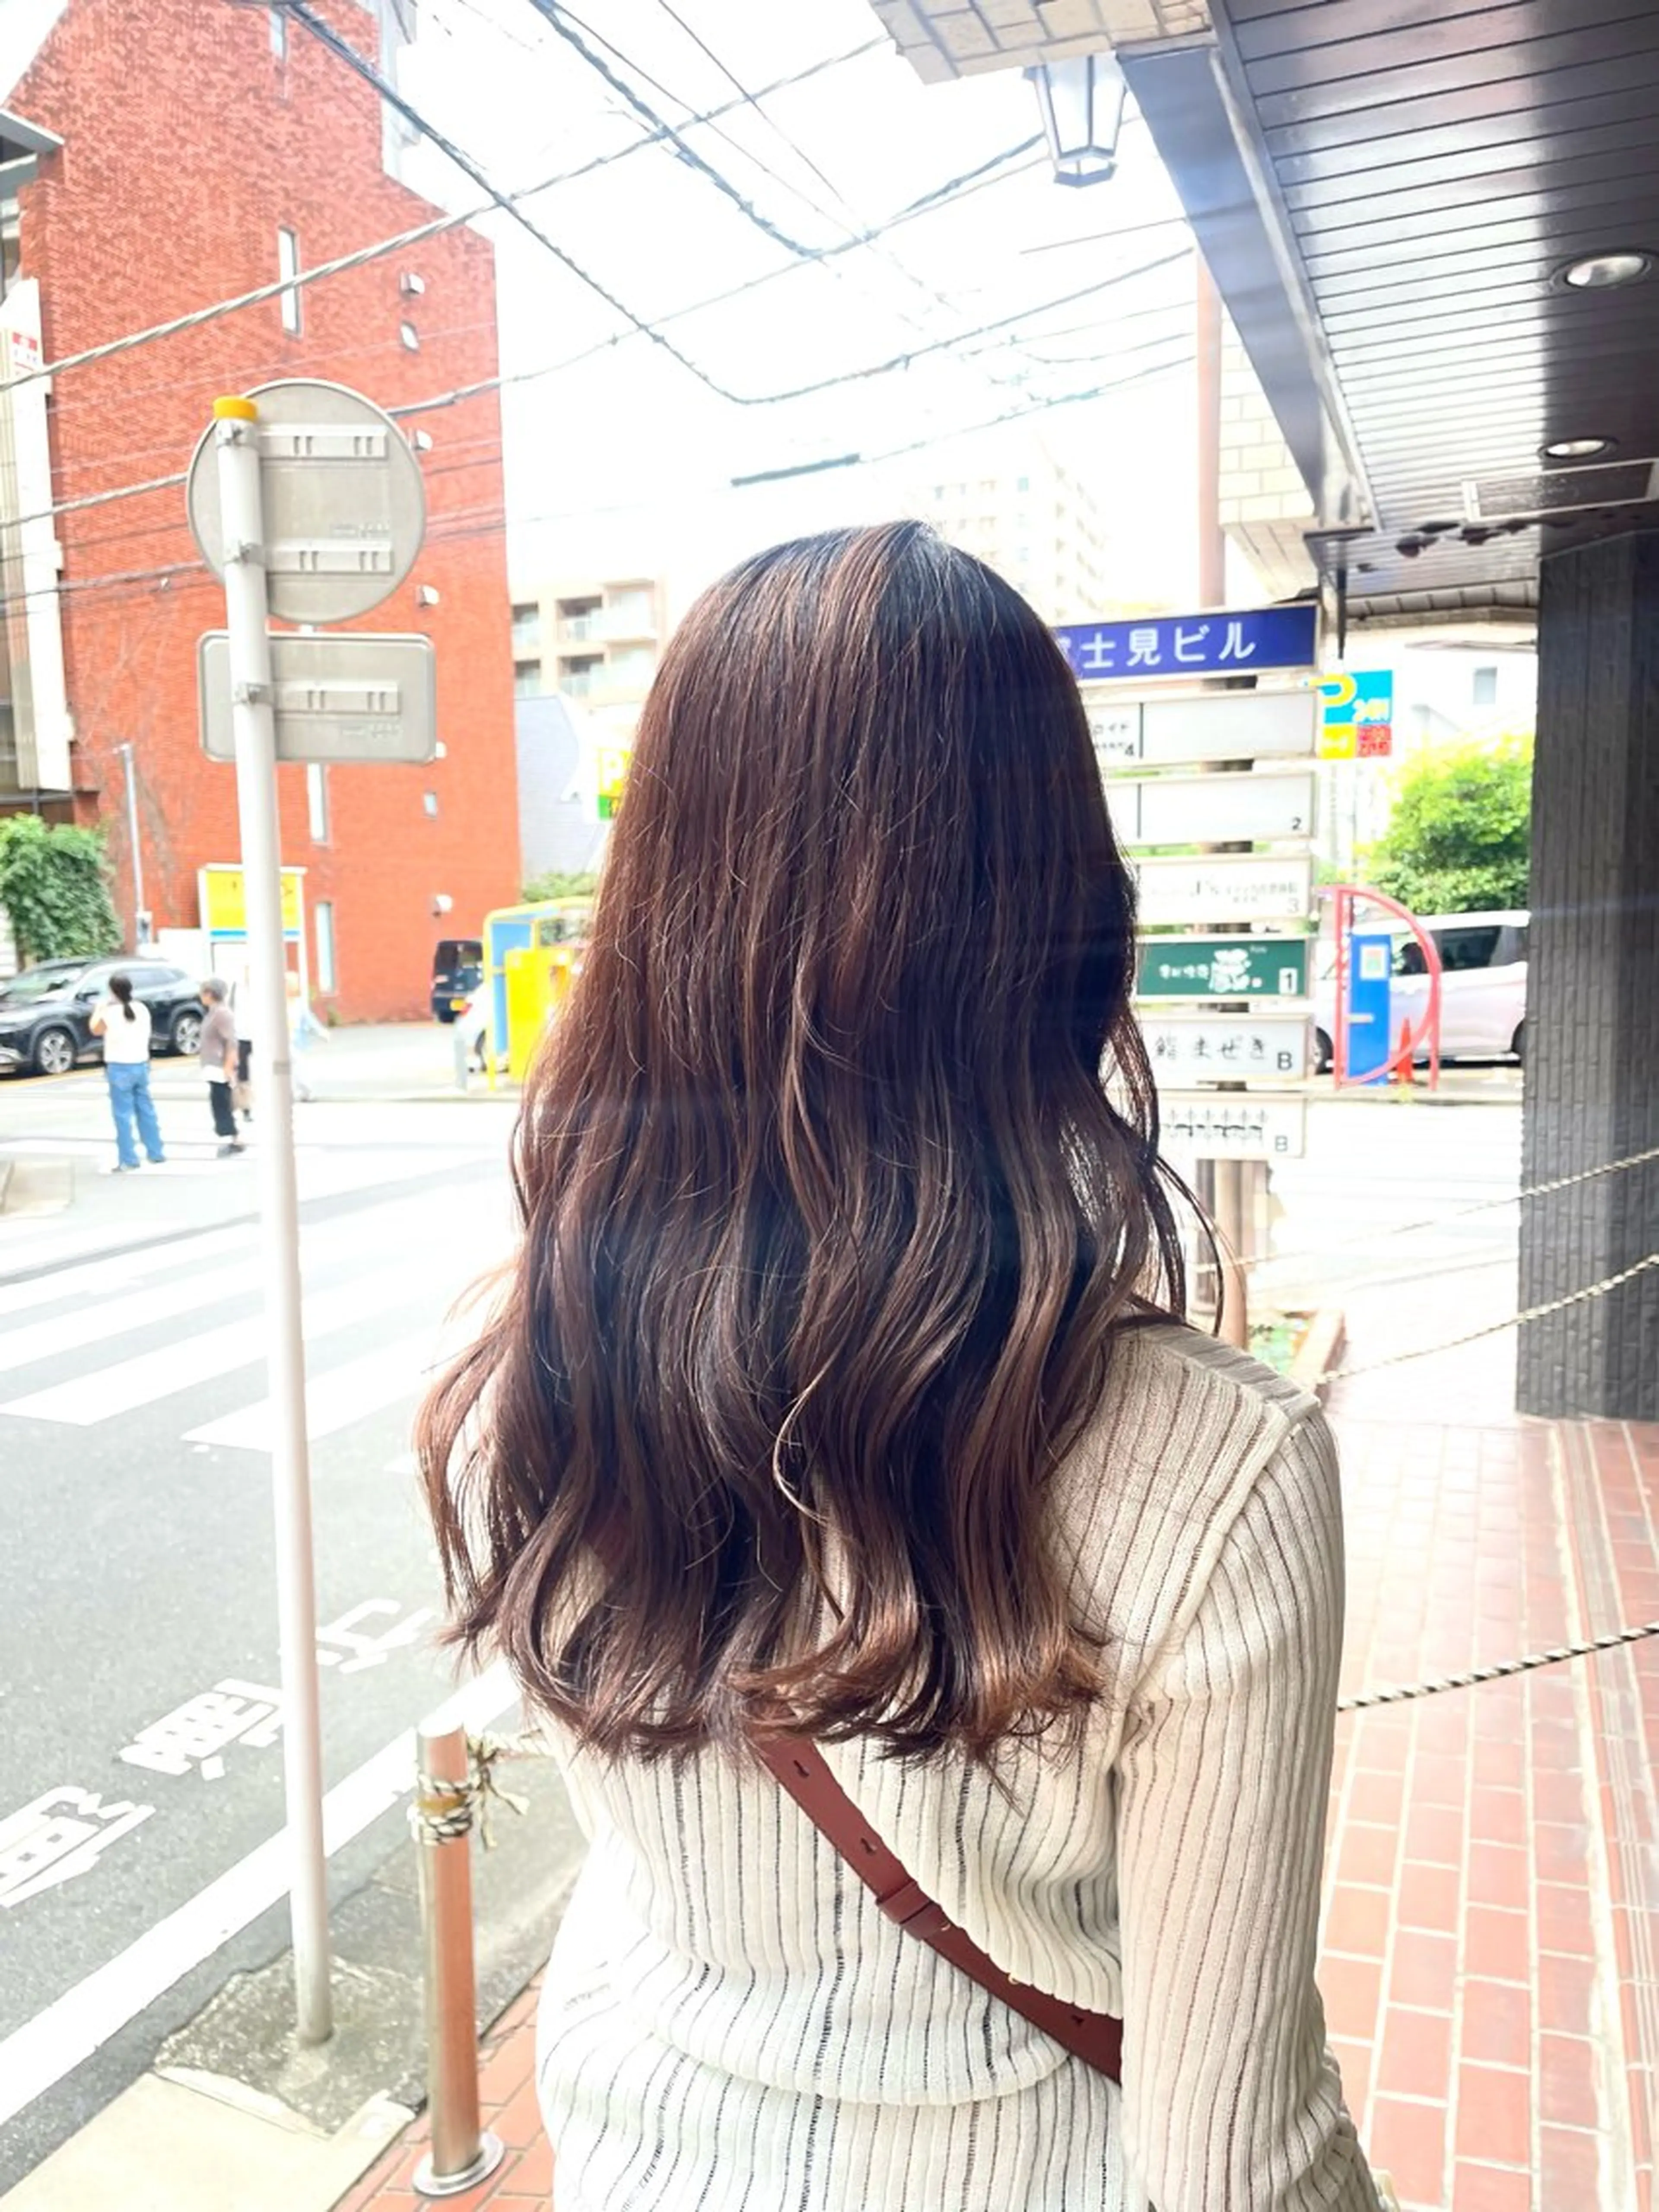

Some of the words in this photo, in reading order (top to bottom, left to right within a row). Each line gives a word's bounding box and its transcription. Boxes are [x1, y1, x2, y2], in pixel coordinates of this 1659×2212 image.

[1124, 742, 1134, 756] 4
[1292, 816, 1302, 831] 2
[1287, 897, 1299, 913] 3
[1278, 1051, 1292, 1071] B
